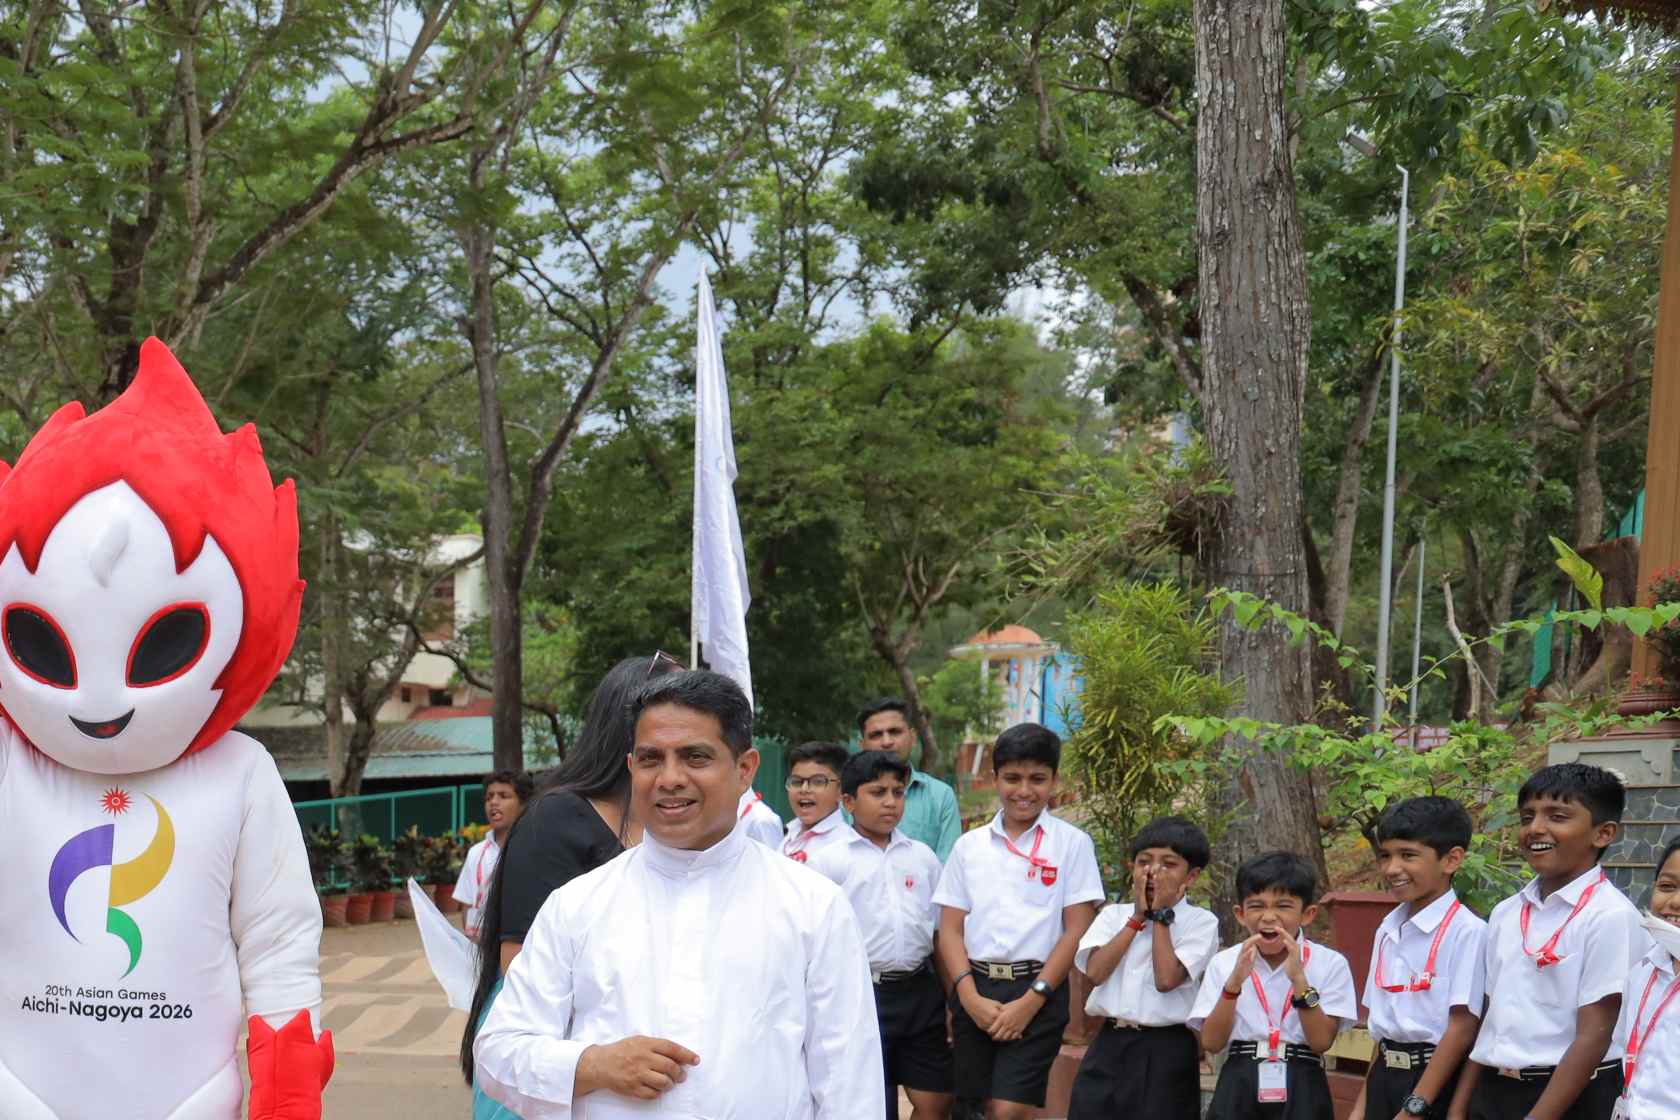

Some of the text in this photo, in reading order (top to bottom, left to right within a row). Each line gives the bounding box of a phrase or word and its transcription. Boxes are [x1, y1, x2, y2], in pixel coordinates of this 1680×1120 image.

[45, 984, 166, 1001] 20th Asian Games
[21, 996, 193, 1022] Aichi-Nagoya 2026
